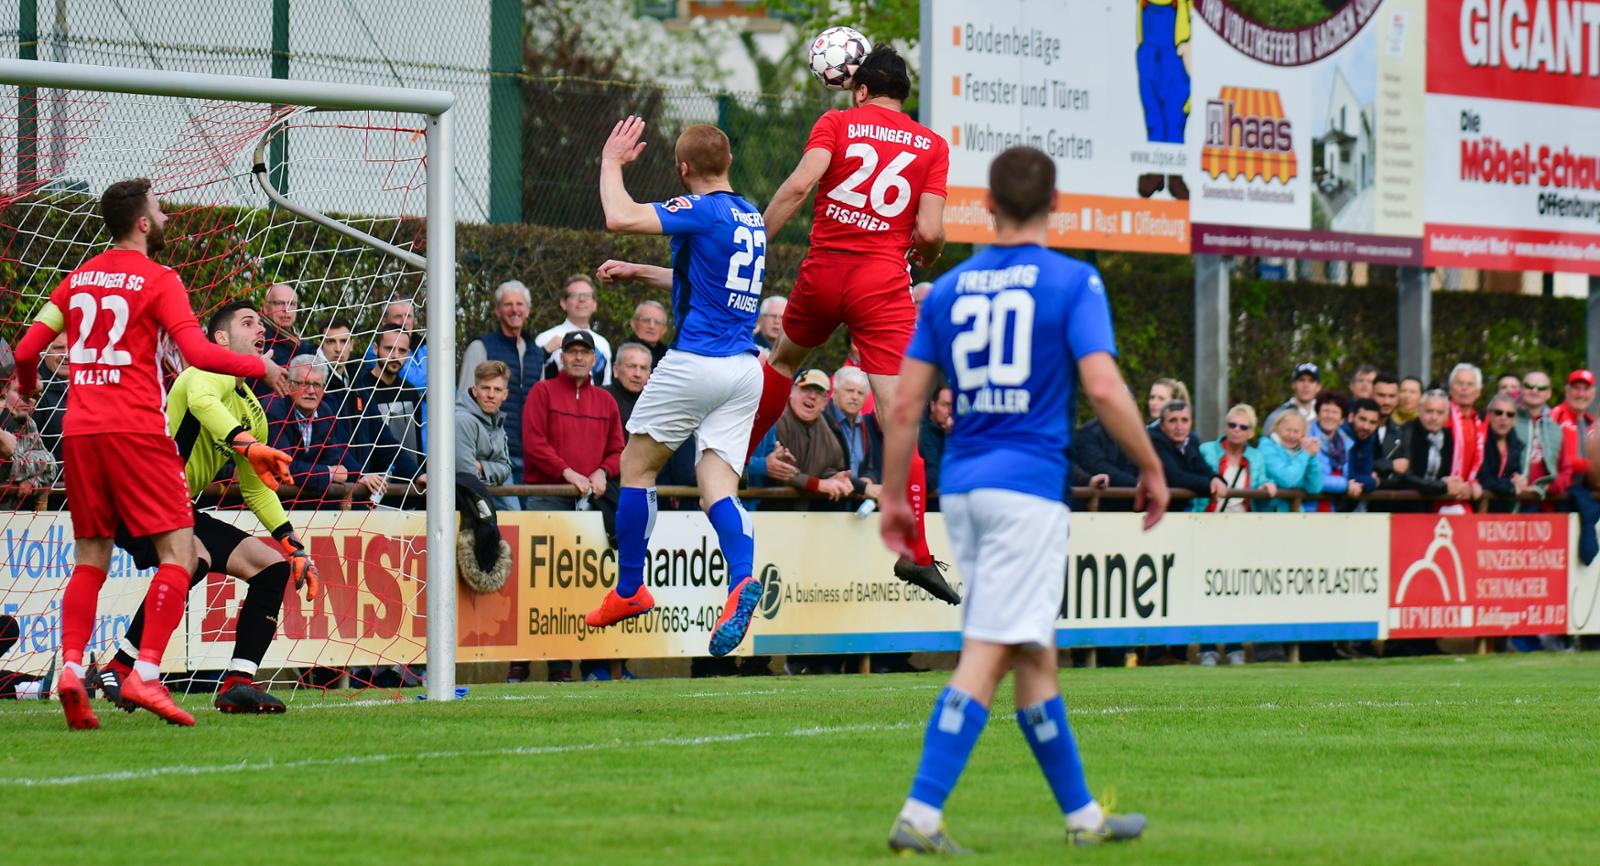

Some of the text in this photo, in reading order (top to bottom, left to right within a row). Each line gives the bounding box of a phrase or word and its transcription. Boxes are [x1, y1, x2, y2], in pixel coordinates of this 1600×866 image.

[965, 22, 1061, 65] Bodenbeläge
[965, 72, 1090, 110] Fenster und Türen
[848, 123, 932, 150] BAHLINGER SC
[1229, 102, 1293, 152] haas
[1460, 110, 1481, 133] Die
[964, 121, 1022, 151] Wohnen
[1047, 128, 1093, 160] Garten
[826, 142, 918, 218] 26
[1095, 208, 1118, 233] Rust
[1135, 210, 1185, 242] Offenburg
[724, 225, 767, 295] 22
[70, 270, 145, 292] BAHLINGER SC
[69, 292, 132, 366] 22
[951, 287, 1036, 391] 20
[74, 368, 121, 386] KLEIN
[1477, 521, 1552, 542] WEINGUT UND
[530, 535, 730, 588] Fleiscande
[784, 583, 792, 603] A
[796, 583, 840, 603] business
[843, 582, 854, 602] of
[857, 582, 900, 602] BARNES
[903, 582, 935, 601] GRO
[1204, 566, 1378, 597] SOLUTIONS FOR PLASTICS
[1476, 577, 1548, 598] SCHUMACHER
[529, 606, 606, 641] Bahling
